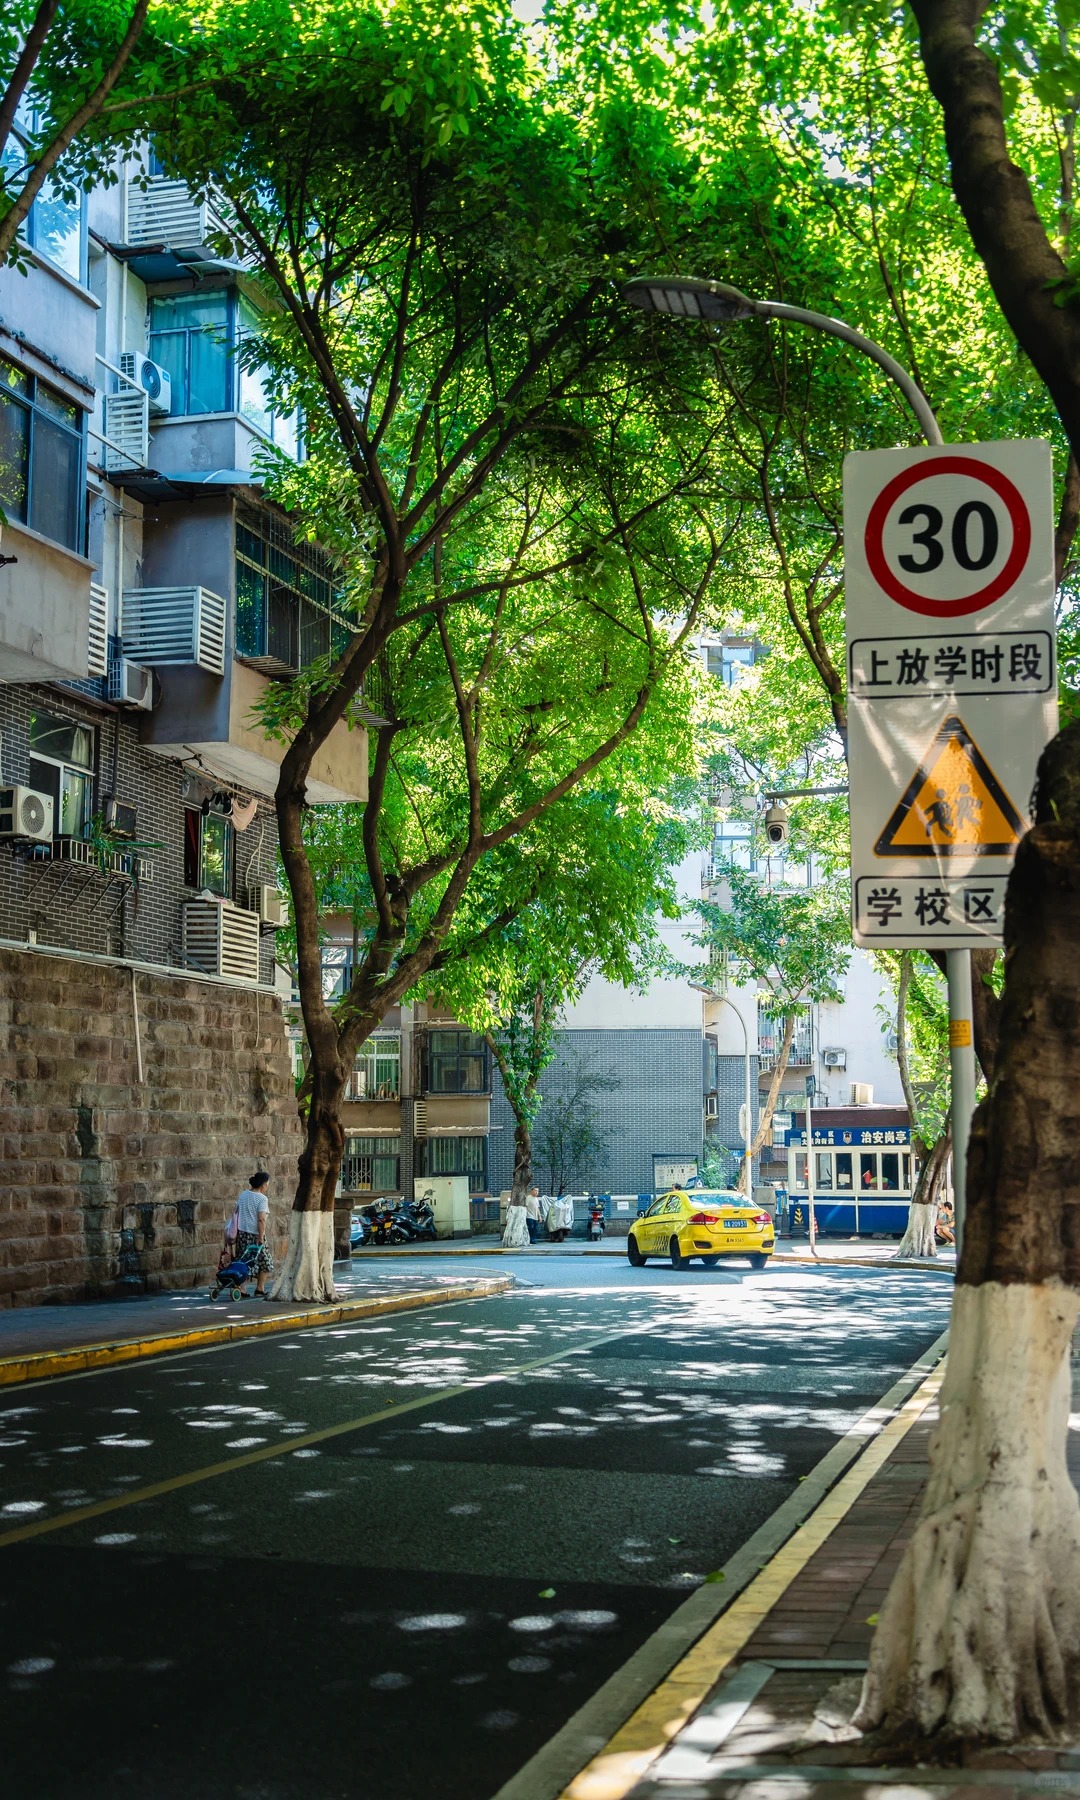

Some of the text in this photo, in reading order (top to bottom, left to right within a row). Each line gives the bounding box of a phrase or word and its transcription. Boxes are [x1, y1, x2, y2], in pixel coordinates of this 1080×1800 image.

[897, 500, 999, 574] 30
[859, 644, 1043, 688] 上放学时段
[867, 887, 998, 927] 学校区
[860, 1130, 907, 1144] 治安岗亭
